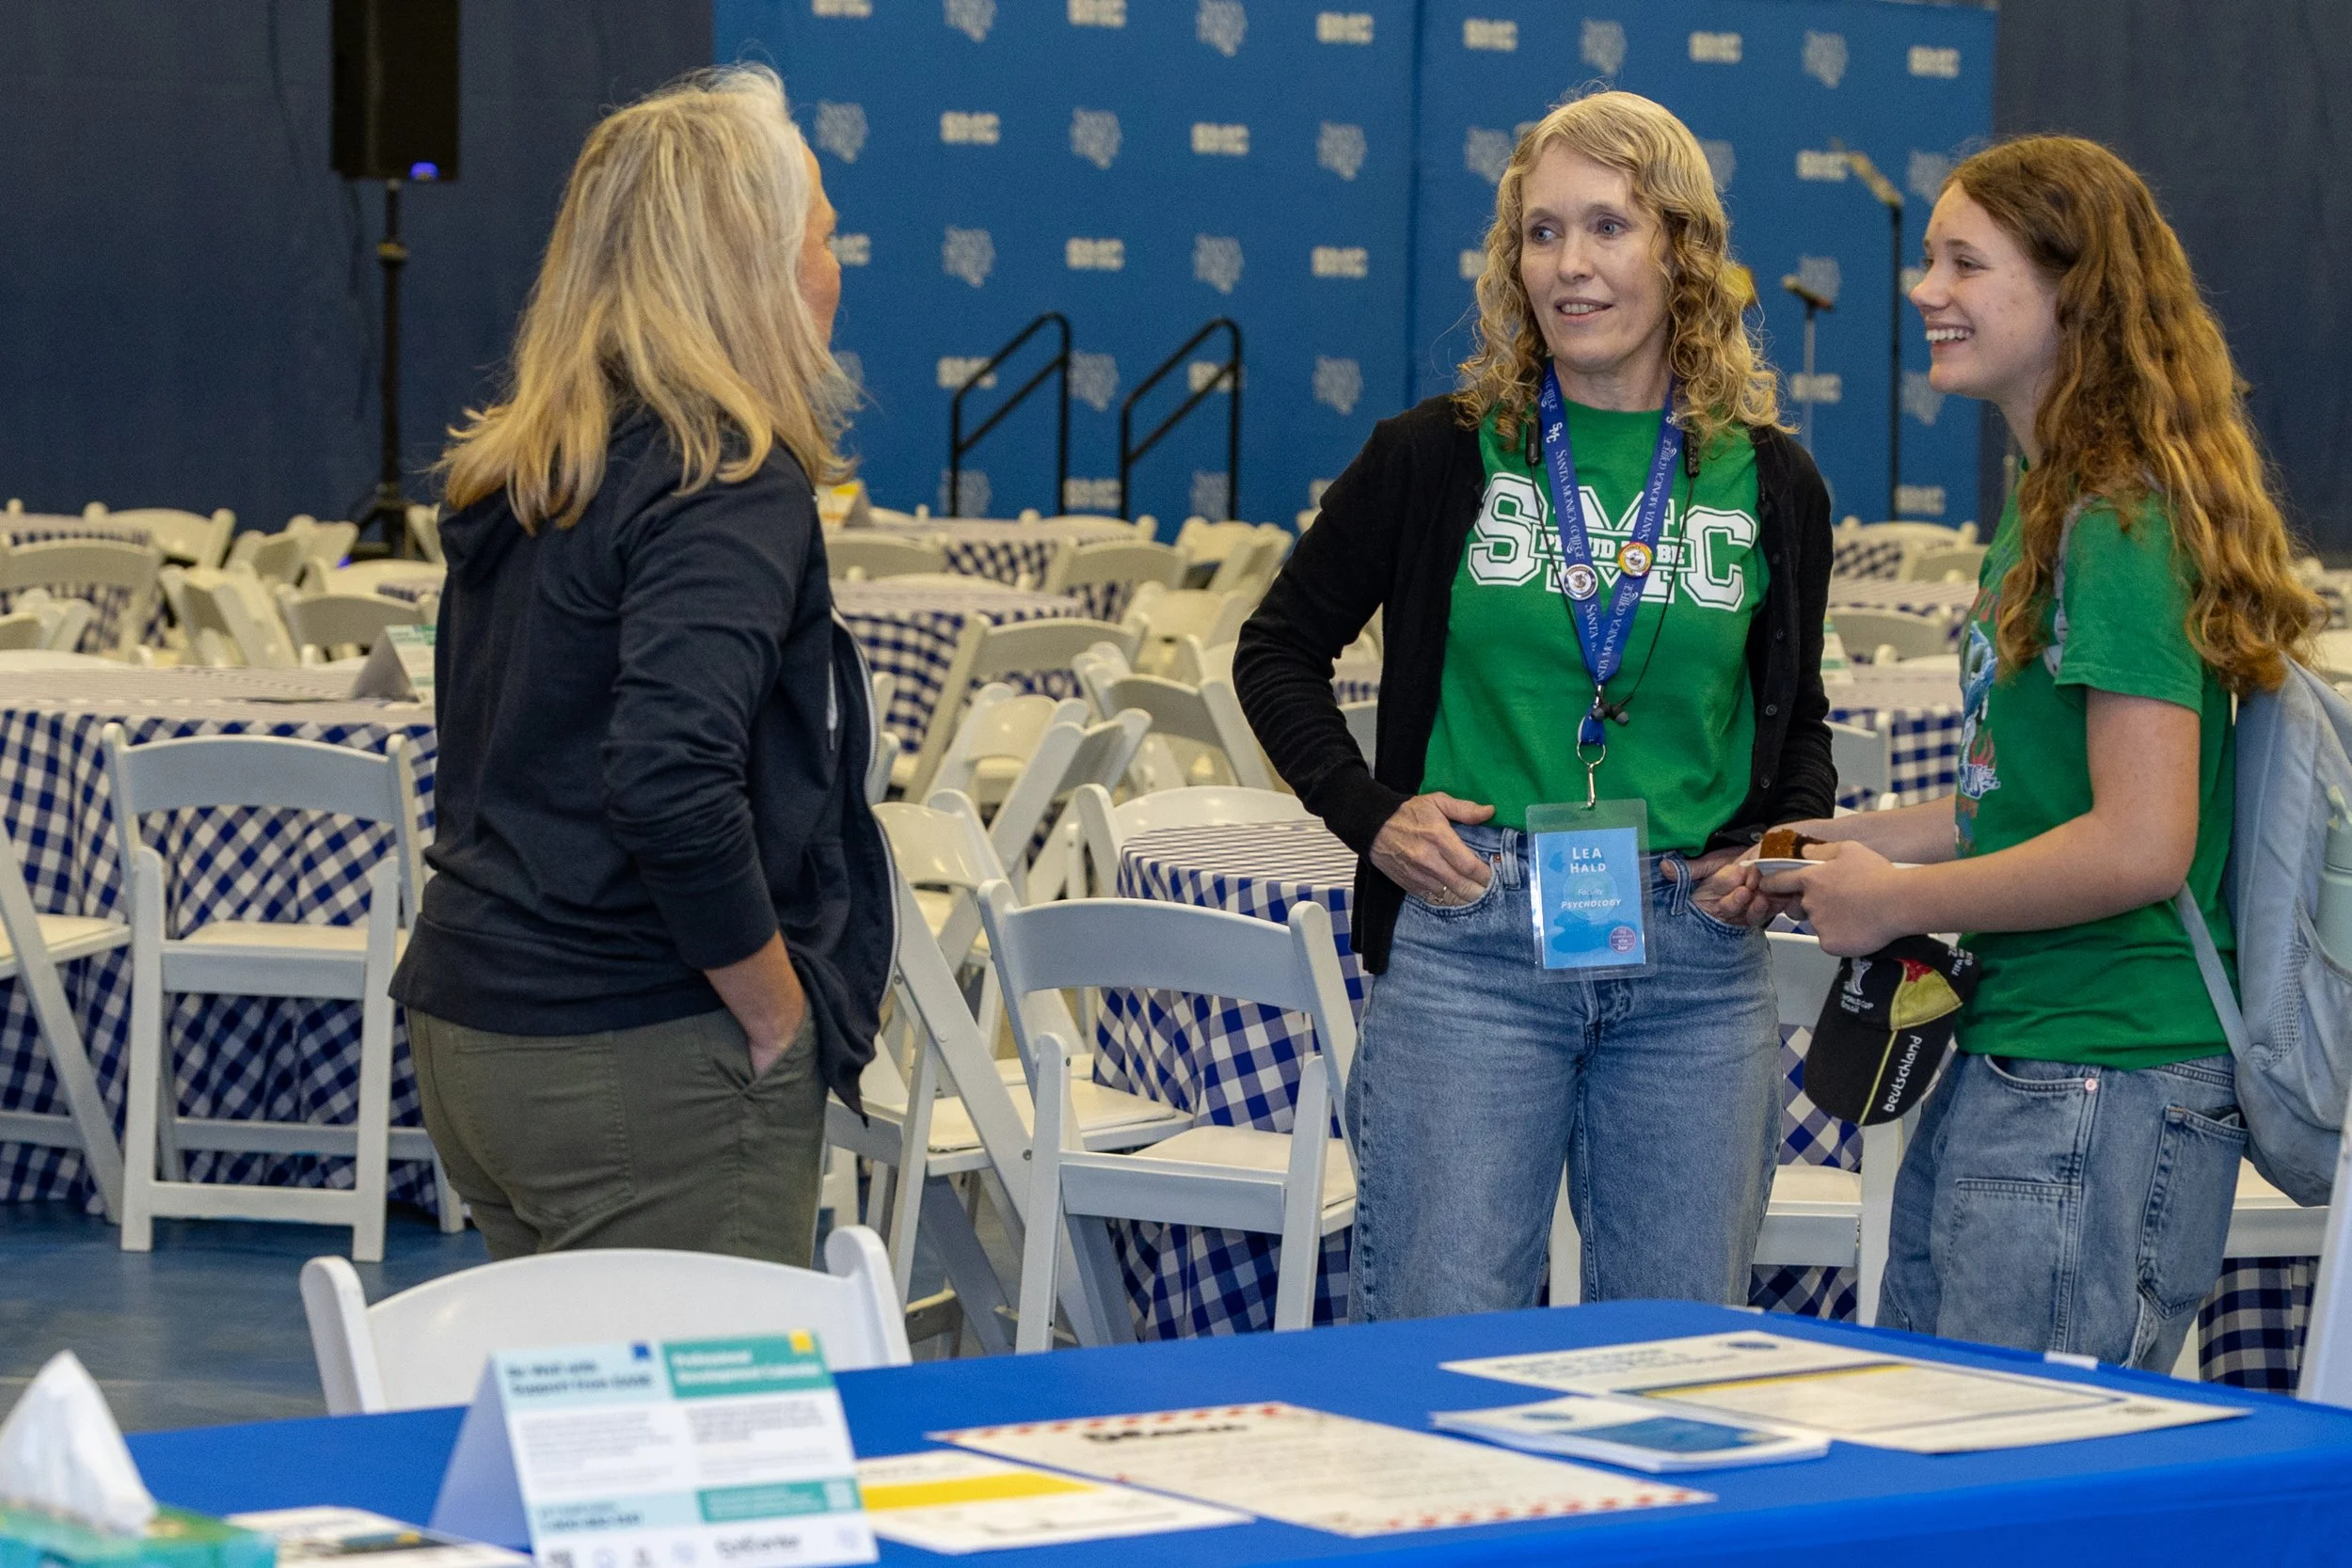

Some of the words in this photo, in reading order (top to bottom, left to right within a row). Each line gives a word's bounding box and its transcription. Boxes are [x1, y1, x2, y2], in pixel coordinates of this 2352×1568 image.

[1546, 422, 1564, 444] SMC
[1555, 450, 1570, 483] SANTA
[1562, 483, 1578, 528] MONICA
[1637, 510, 1653, 543] SANTA
[1647, 471, 1665, 509] MONICA
[1658, 437, 1675, 470] COLLEGE
[1568, 525, 1585, 561] COLLEGE
[1655, 544, 1686, 564] BE
[1584, 603, 1599, 639] SANTA
[1602, 618, 1623, 657] MONICA
[1615, 583, 1637, 617] COLLEGE
[1569, 863, 1607, 874] HALD
[1572, 847, 1602, 860] LEA
[1561, 898, 1622, 910] PSYCHOLOGY
